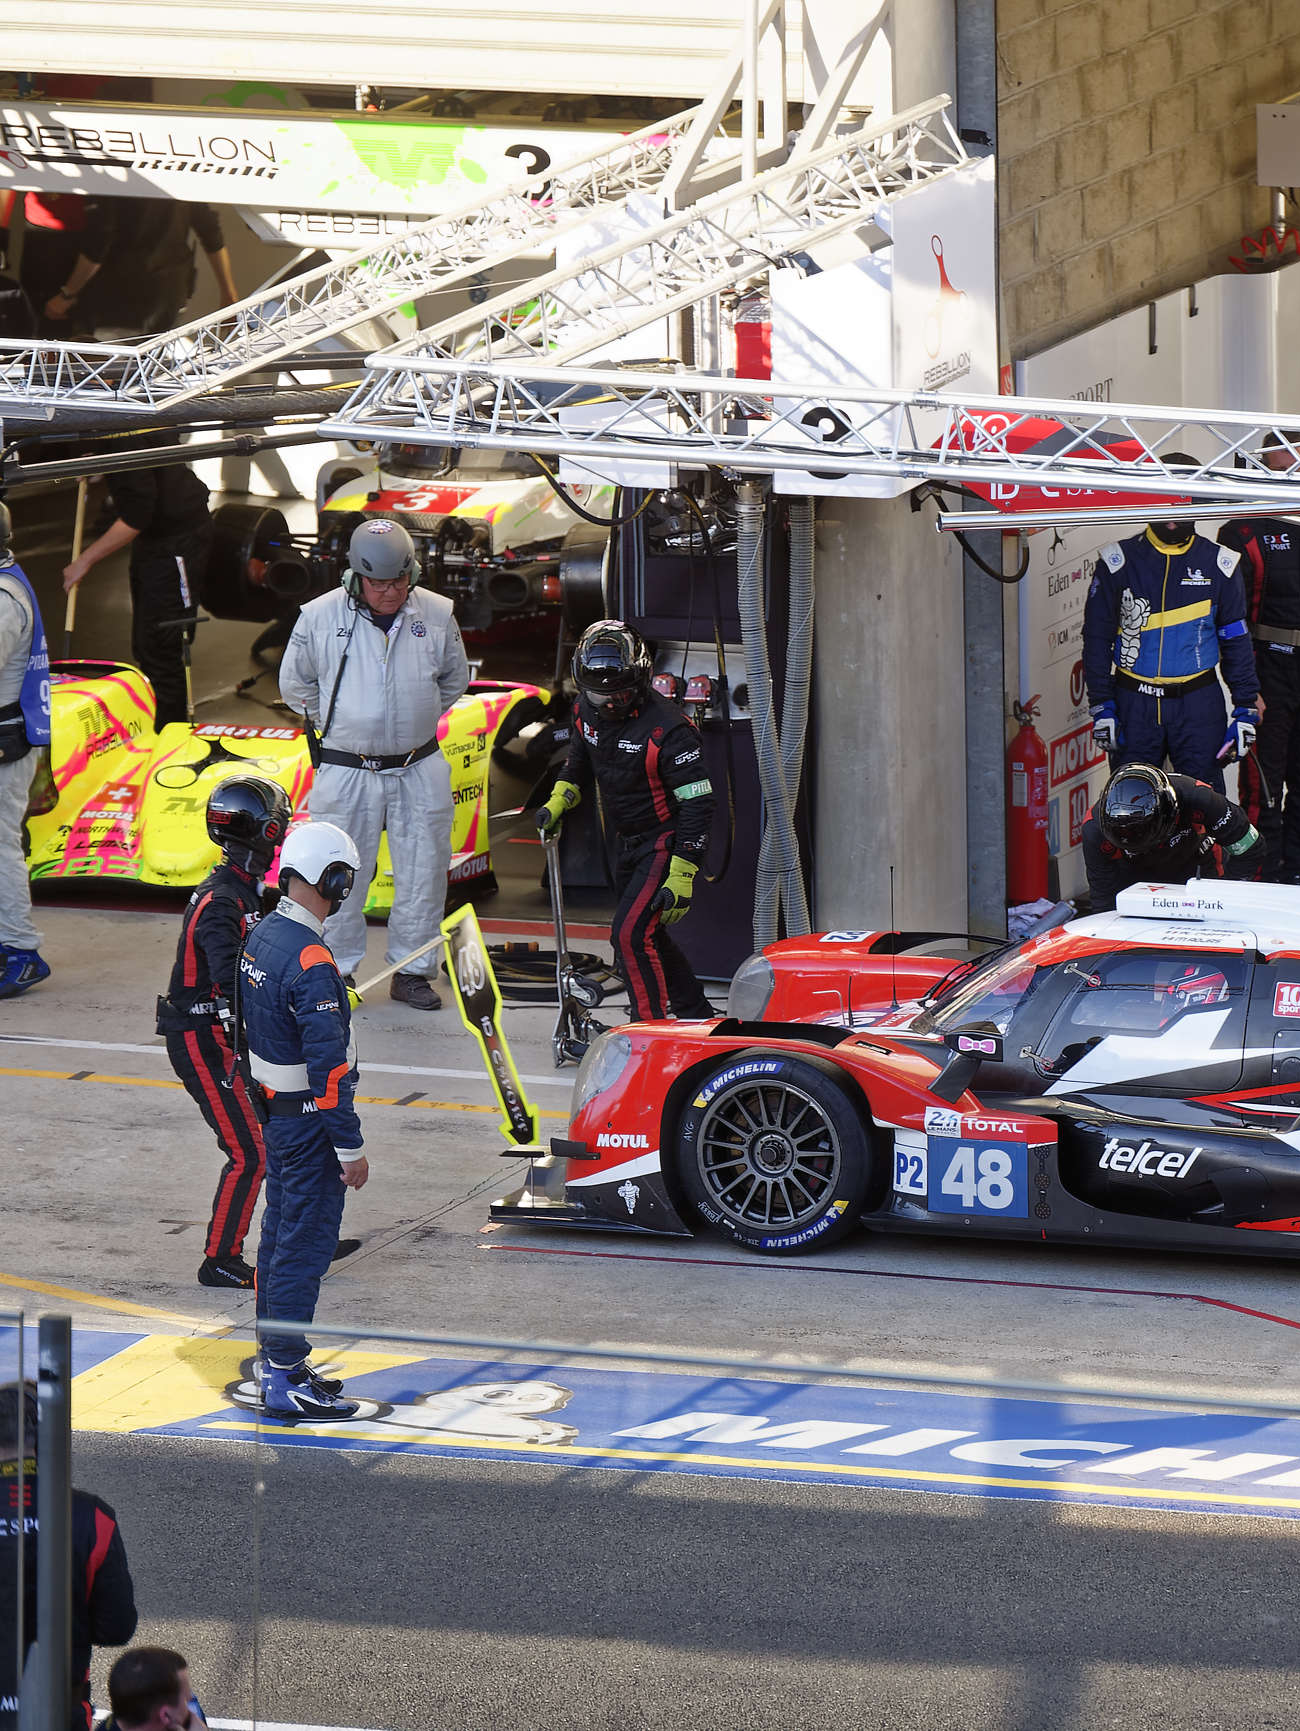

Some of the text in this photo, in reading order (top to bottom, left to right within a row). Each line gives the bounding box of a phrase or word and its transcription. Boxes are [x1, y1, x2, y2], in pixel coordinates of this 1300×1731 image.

[392, 491, 439, 512] 3
[195, 725, 297, 740] MOTUL
[79, 810, 134, 822] MOTUL
[1152, 897, 1224, 910] Eden Park
[712, 1062, 777, 1091] MICHELIN
[963, 1117, 1024, 1134] TOTAL
[596, 1133, 650, 1149] MOTUL
[1099, 1137, 1203, 1179] telcel
[895, 1150, 924, 1190] P2
[941, 1145, 1015, 1210] 48
[766, 1217, 830, 1248] MICHELIN
